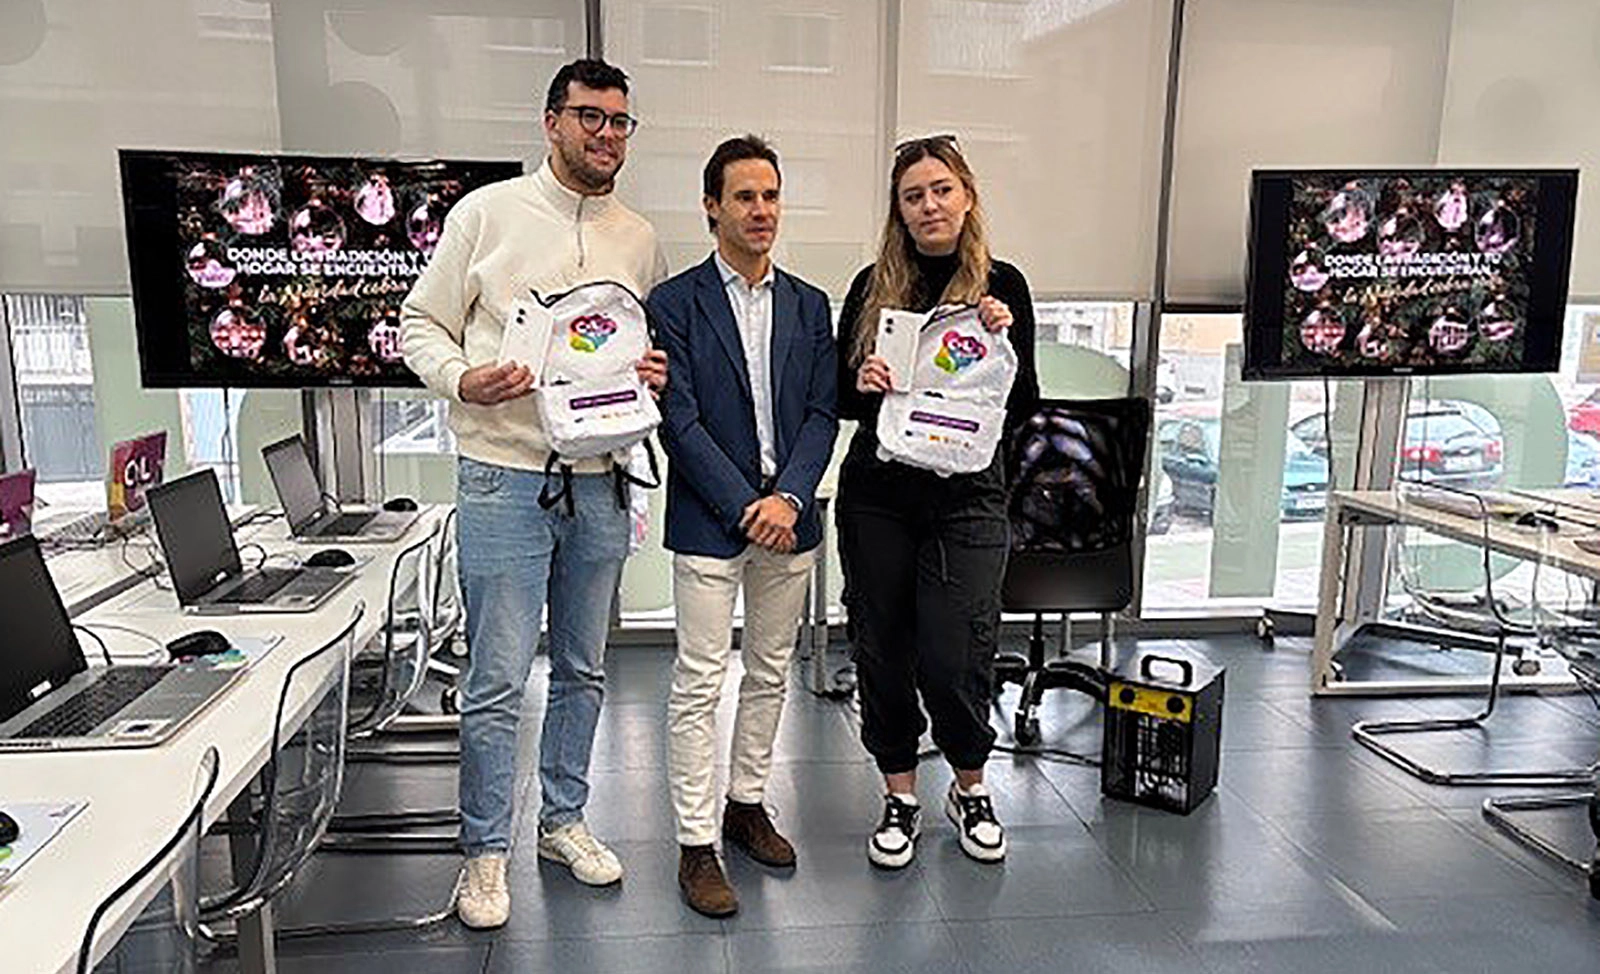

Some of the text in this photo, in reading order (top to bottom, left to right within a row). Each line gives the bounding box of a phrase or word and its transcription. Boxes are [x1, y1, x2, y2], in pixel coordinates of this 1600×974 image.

[227, 247, 288, 262] DONDE
[290, 250, 313, 262] LA
[314, 248, 406, 263] TRADICIÓN
[407, 251, 419, 266] Y
[1325, 253, 1373, 267] DONDE
[236, 261, 298, 276] HOGAR
[300, 262, 321, 276] SE
[1329, 265, 1378, 278] HOGAR
